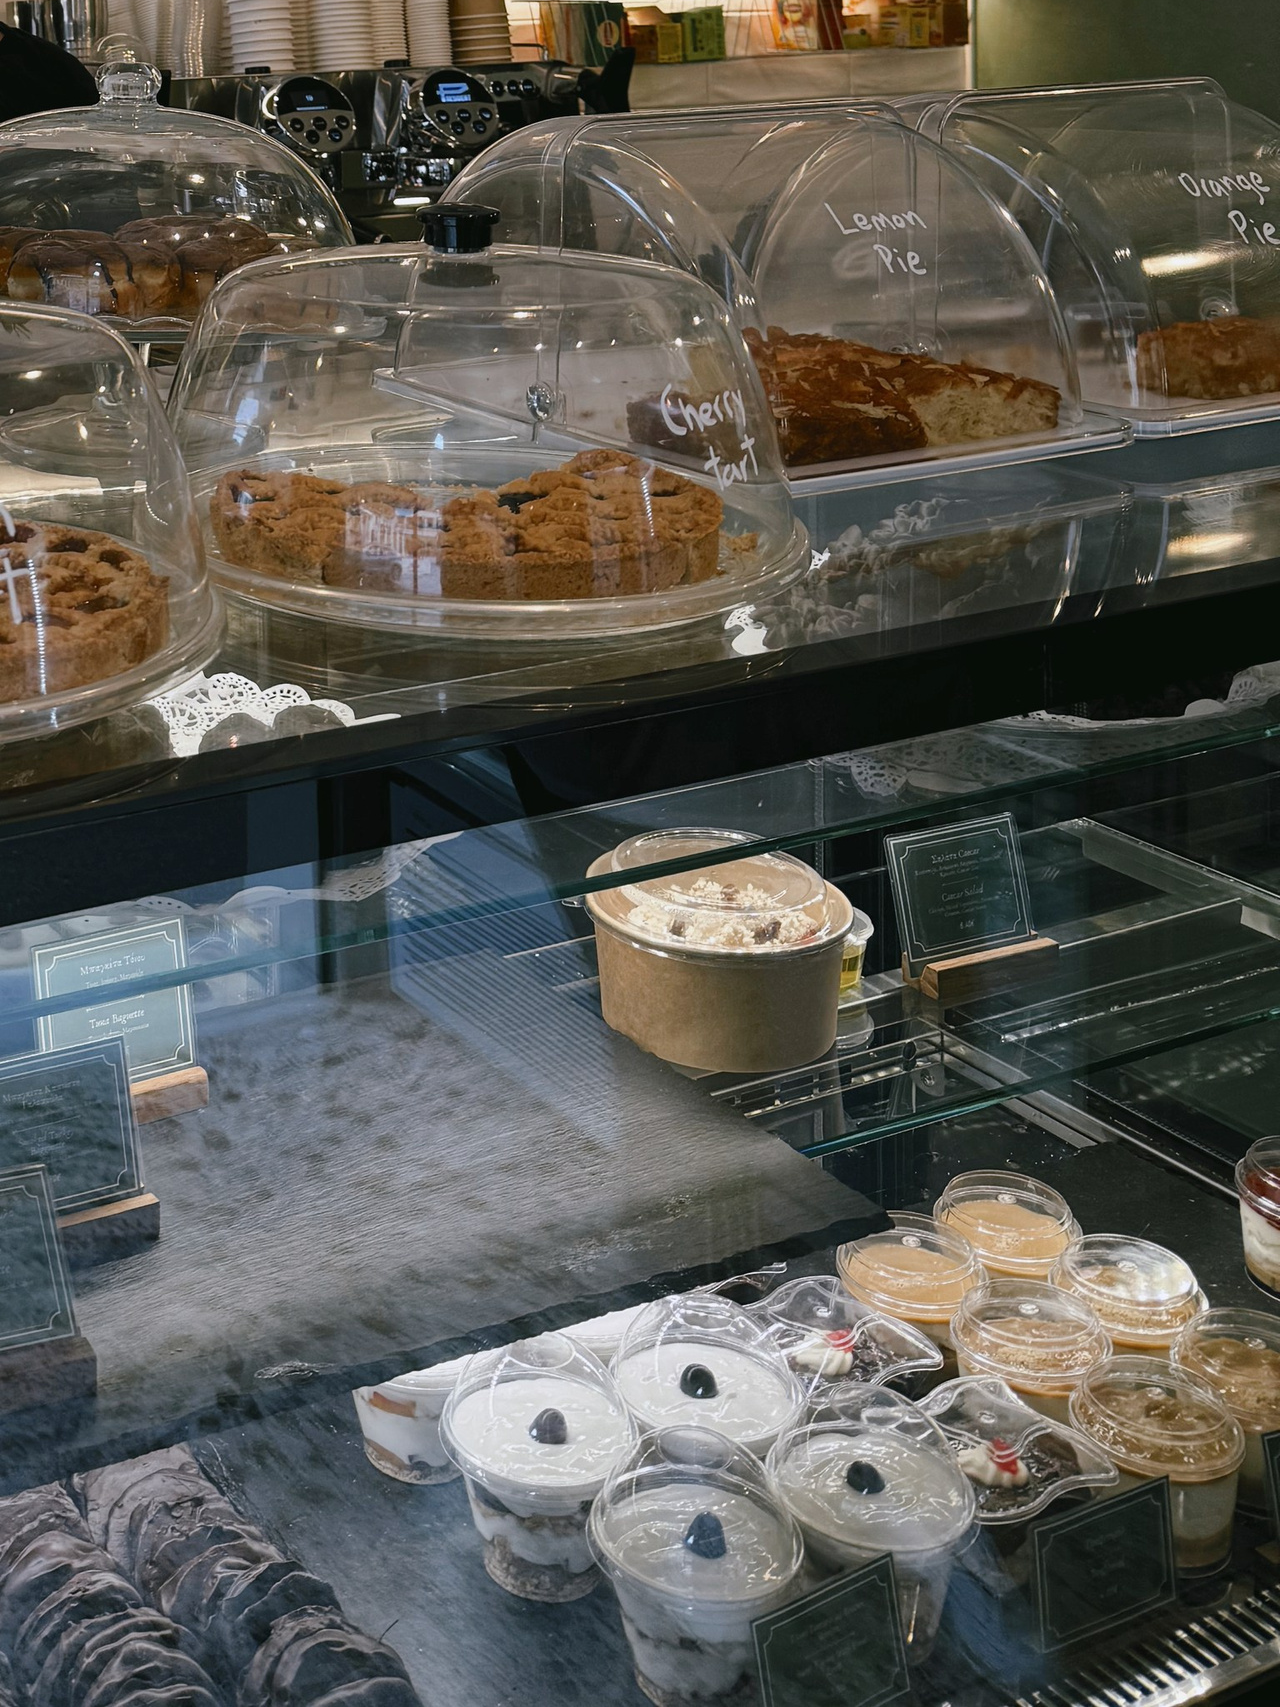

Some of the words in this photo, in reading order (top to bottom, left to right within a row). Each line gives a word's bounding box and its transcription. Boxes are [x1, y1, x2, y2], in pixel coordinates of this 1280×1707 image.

[1178, 171, 1270, 205] Orange
[824, 202, 927, 235] Lemon
[1228, 210, 1280, 245] Pie
[873, 244, 927, 275] Pie
[660, 383, 746, 436] Cherry
